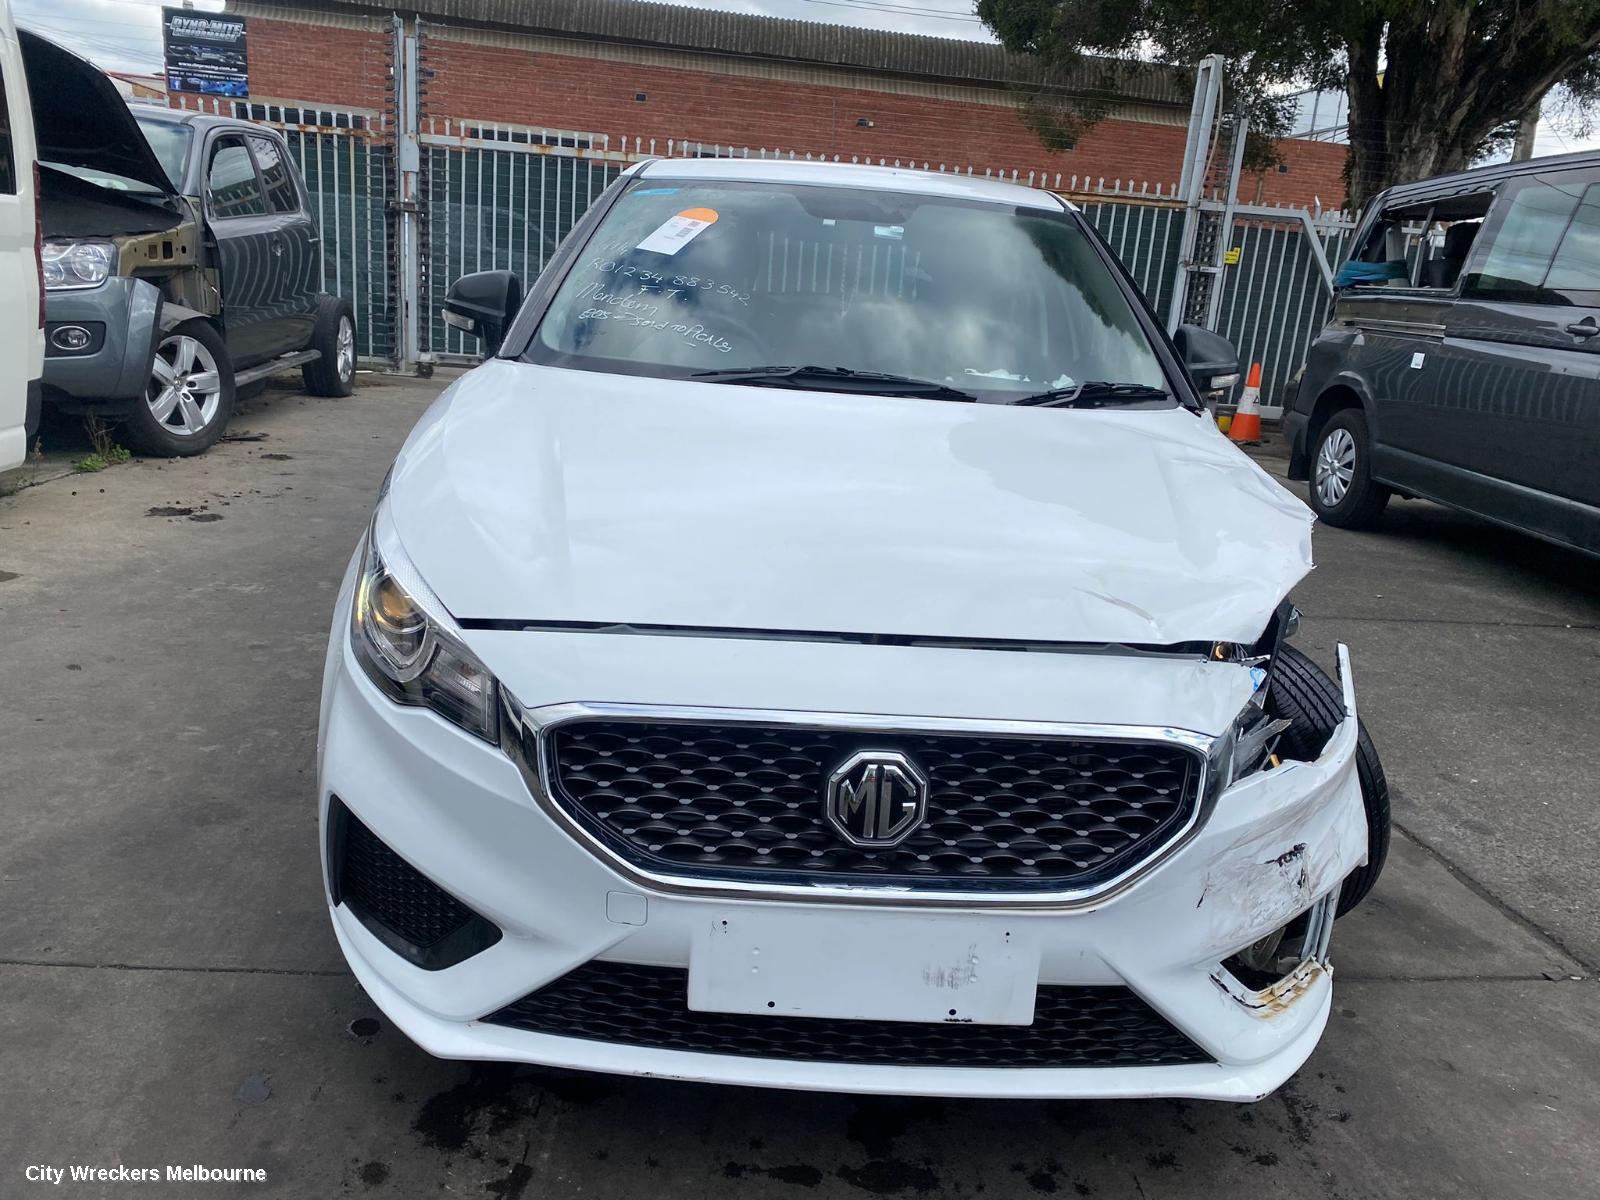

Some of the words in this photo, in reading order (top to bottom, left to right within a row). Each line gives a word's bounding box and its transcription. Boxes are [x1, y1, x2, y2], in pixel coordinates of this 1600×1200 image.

[171, 17, 242, 35] DYNO-MITE
[173, 27, 236, 41] PERFORMANCE
[838, 763, 917, 839] MG
